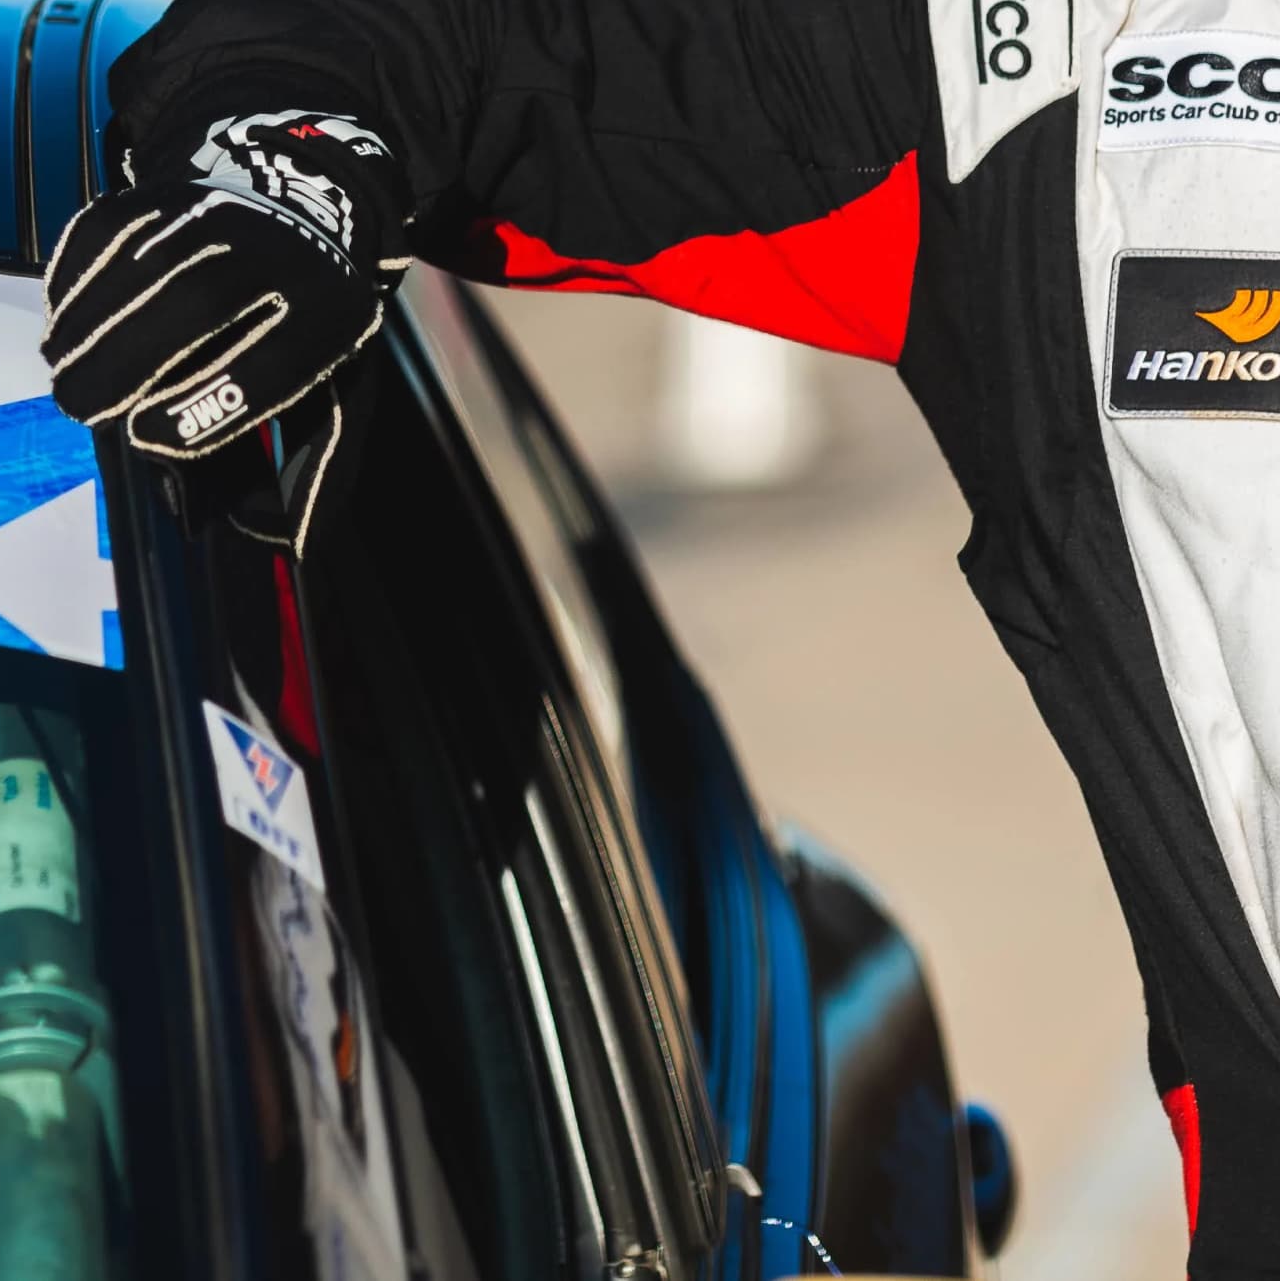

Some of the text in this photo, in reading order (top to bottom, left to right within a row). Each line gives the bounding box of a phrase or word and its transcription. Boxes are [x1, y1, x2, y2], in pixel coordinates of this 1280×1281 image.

[1104, 106, 1166, 128] Sports
[1171, 103, 1204, 119] Car
[1208, 101, 1260, 121] Club
[177, 382, 244, 439] OMP
